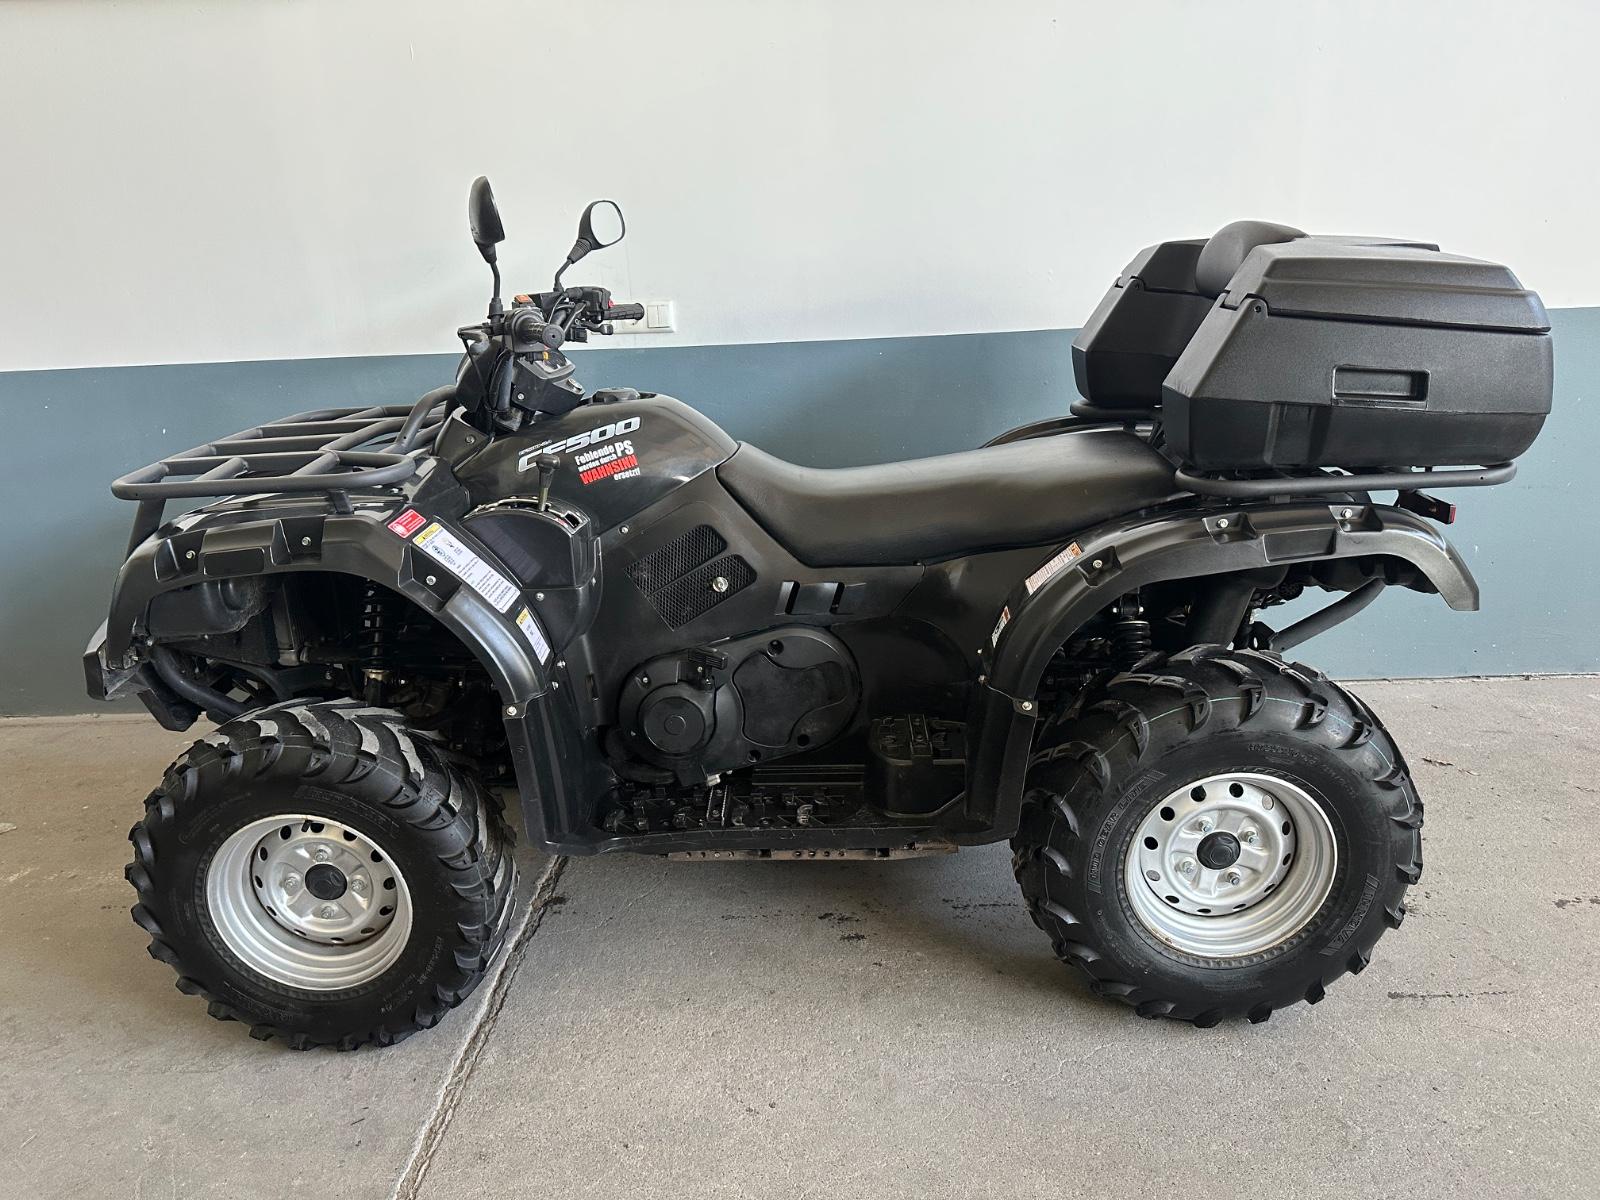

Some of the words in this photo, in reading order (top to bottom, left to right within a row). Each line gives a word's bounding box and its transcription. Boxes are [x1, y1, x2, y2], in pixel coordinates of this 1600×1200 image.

[518, 416, 641, 473] CF500
[575, 444, 615, 466] Fehlende
[614, 440, 635, 457] PS
[579, 454, 639, 485] WAHNSINN
